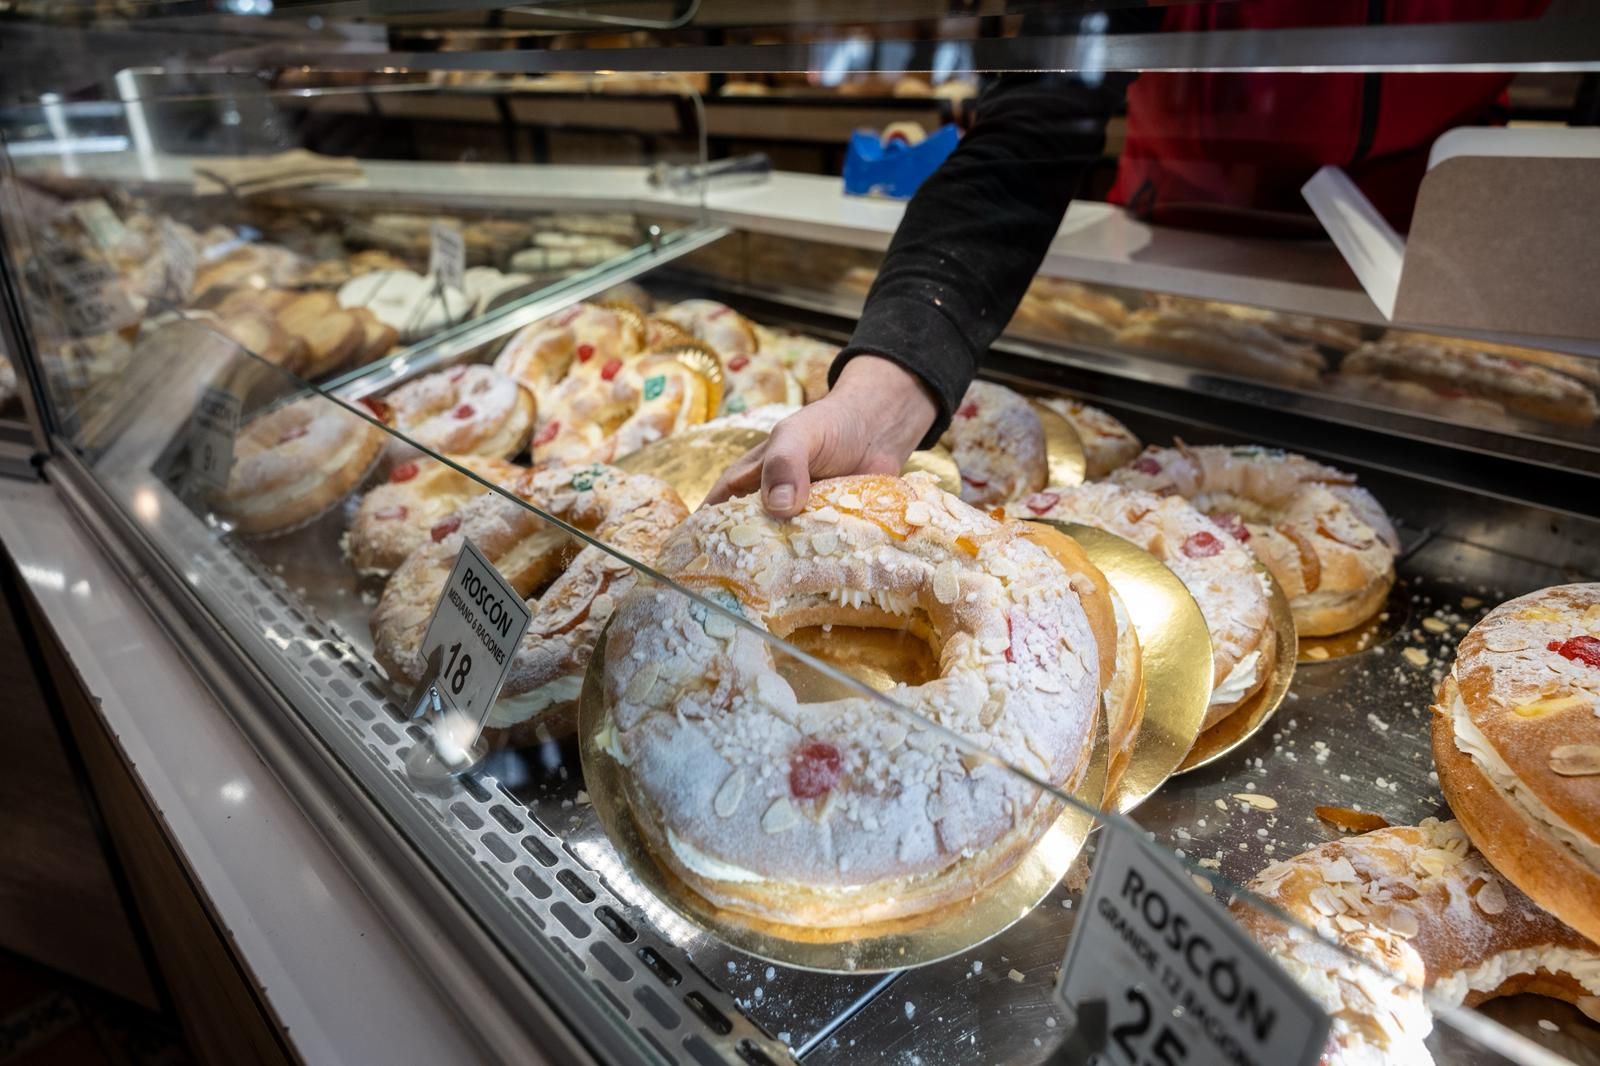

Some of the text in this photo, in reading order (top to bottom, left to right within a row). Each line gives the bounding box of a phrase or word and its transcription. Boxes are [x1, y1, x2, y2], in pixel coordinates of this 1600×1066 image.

[448, 587, 506, 666] MEDIANO 6 RACIONES
[461, 567, 513, 638] ROSCÓN
[443, 642, 472, 695] 18
[1121, 867, 1278, 1042] ROSCÓN
[1112, 986, 1188, 1066] 25
